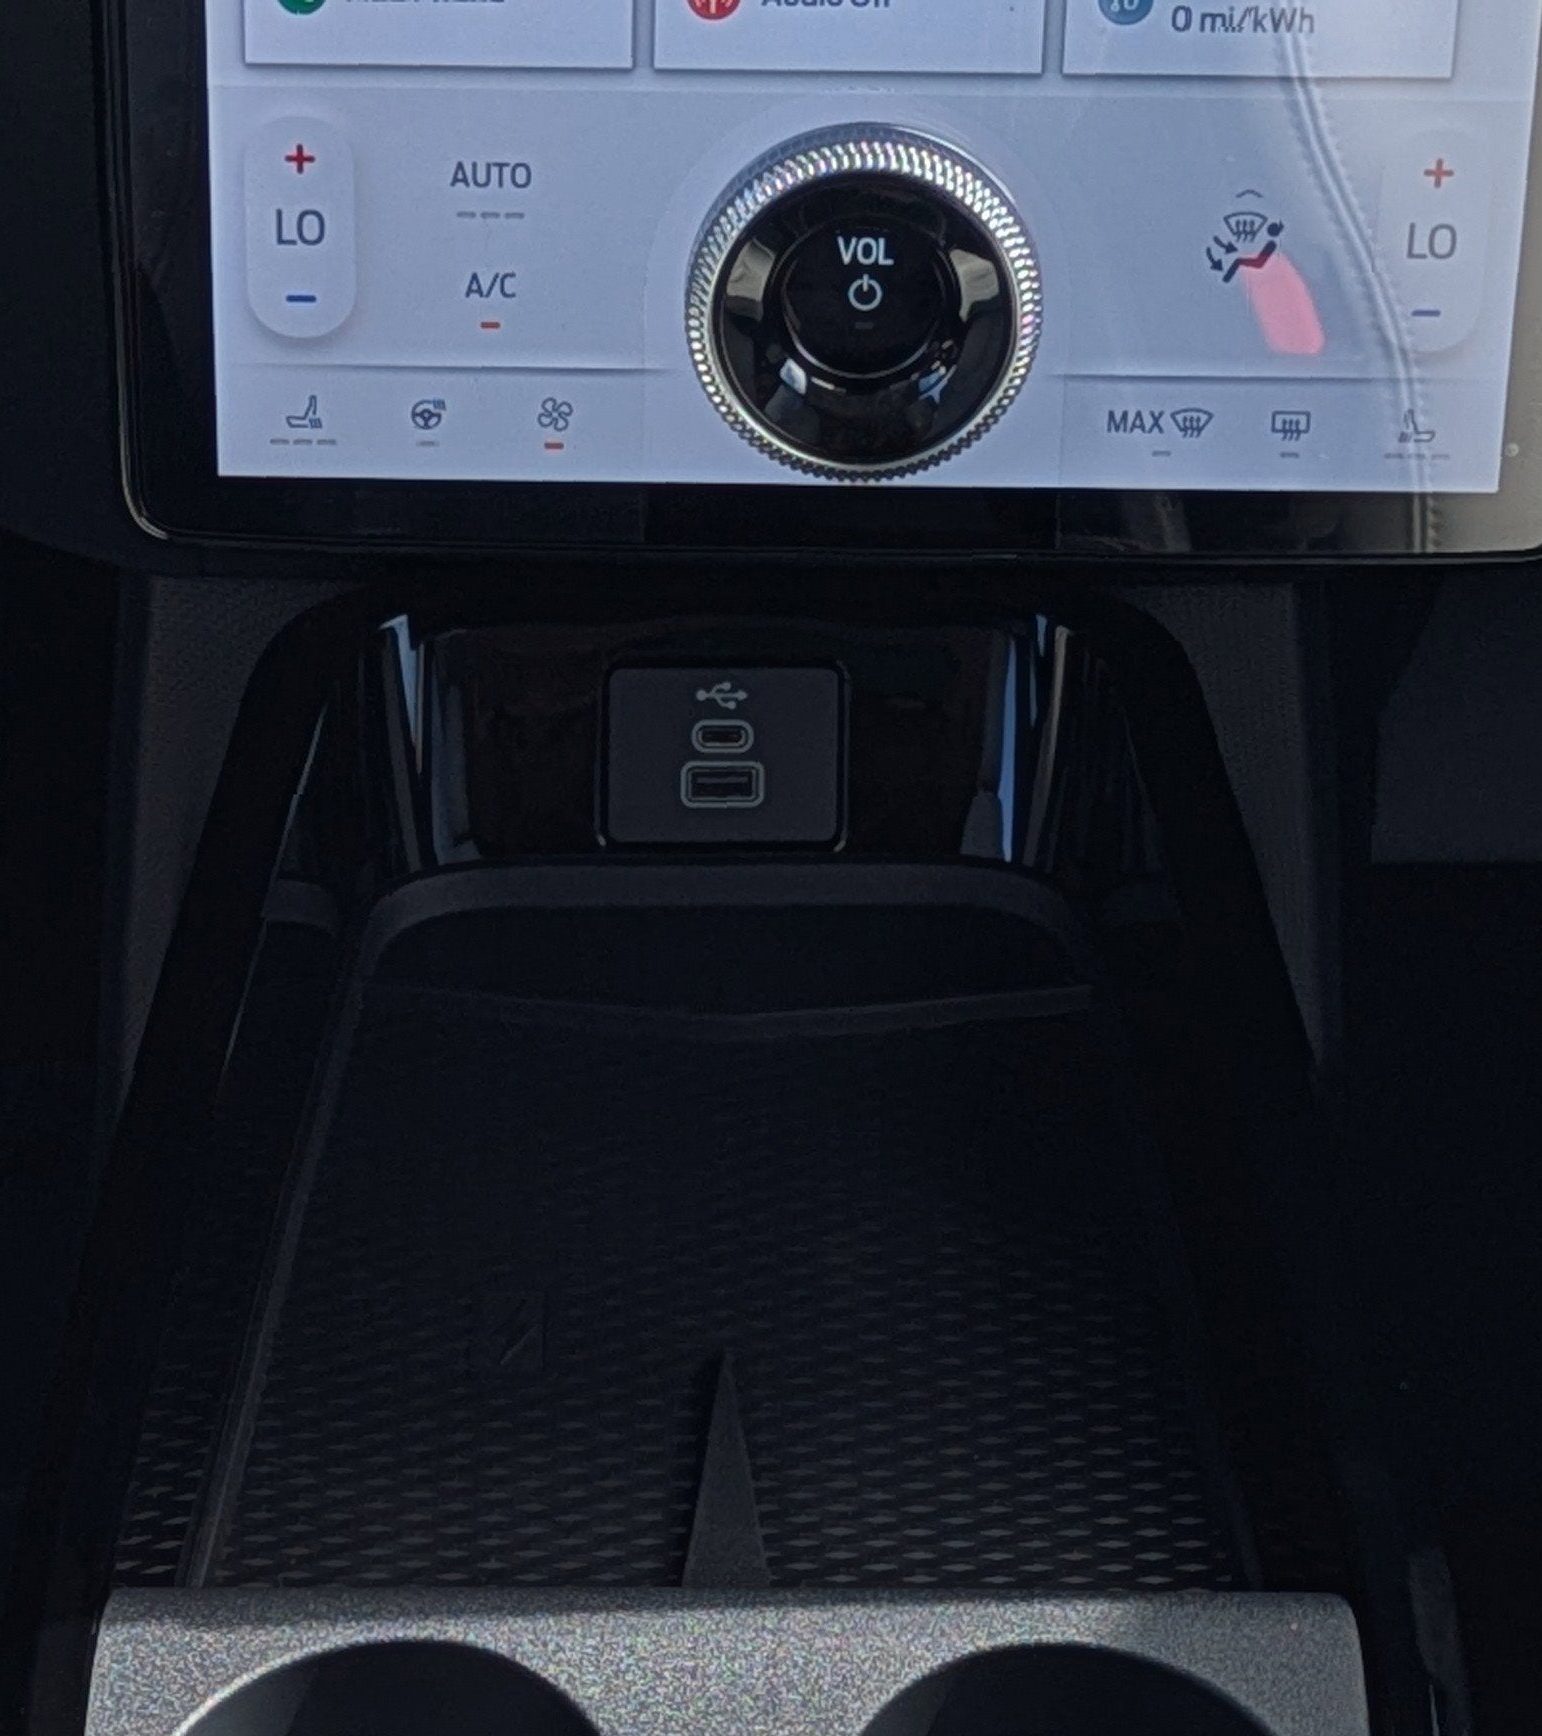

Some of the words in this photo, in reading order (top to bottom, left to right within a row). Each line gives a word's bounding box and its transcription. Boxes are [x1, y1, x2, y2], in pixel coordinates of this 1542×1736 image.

[1171, 5, 1193, 32] 0
[1199, 6, 1315, 33] mi/kWh
[450, 160, 533, 190] AUTO
[275, 209, 326, 247] LO
[1406, 221, 1458, 262] LO
[837, 235, 895, 268] VOL
[464, 271, 518, 299] A/C
[1105, 409, 1165, 437] MAX
